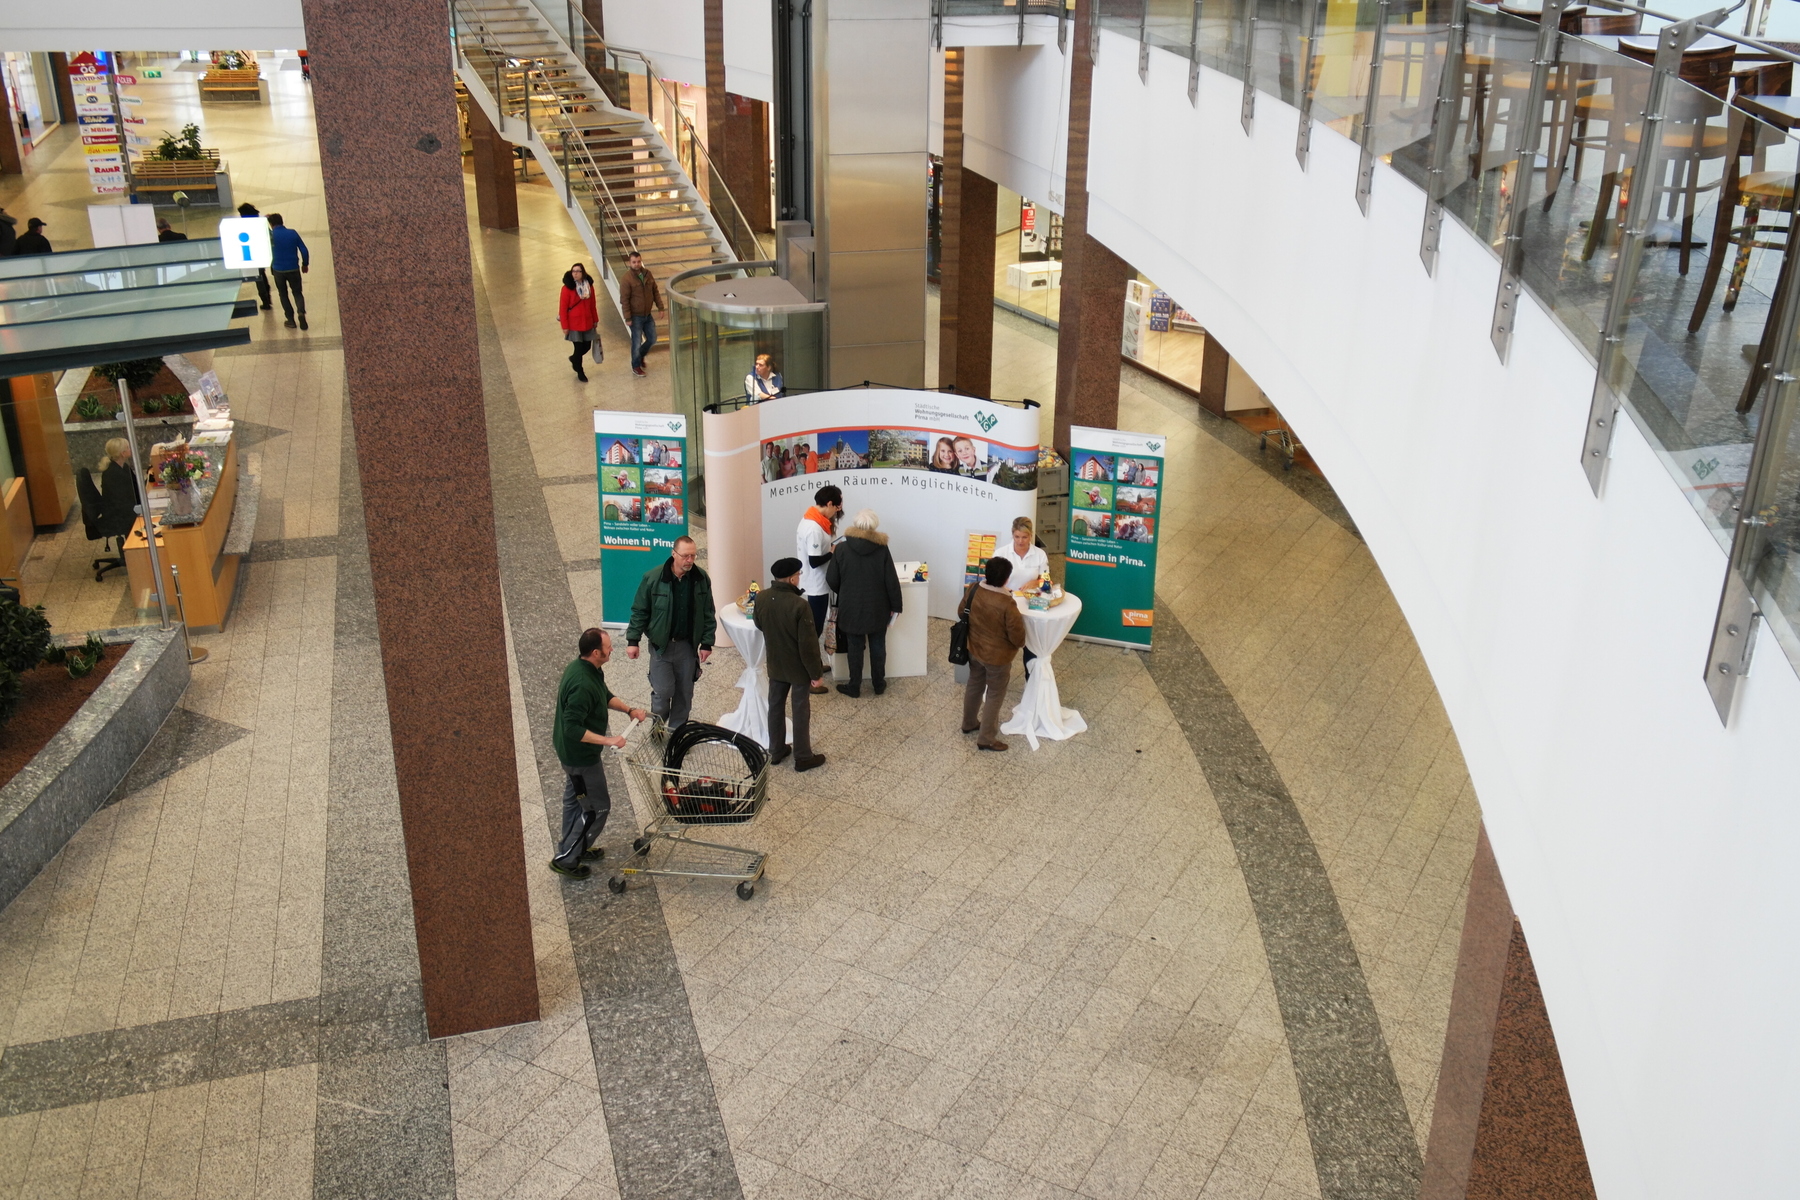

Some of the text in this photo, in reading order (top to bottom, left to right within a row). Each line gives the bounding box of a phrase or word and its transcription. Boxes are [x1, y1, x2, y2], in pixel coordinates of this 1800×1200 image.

[80, 66, 96, 74] OG
[914, 409, 969, 420] Wohnungsgesellschaft
[844, 476, 894, 486] Räume.
[901, 475, 998, 502] Möglichkeiten.
[604, 535, 639, 545] Wohnen
[642, 537, 650, 546] in
[1070, 549, 1146, 567] Wohnen in Pirna.
[1129, 611, 1148, 620] pirna
